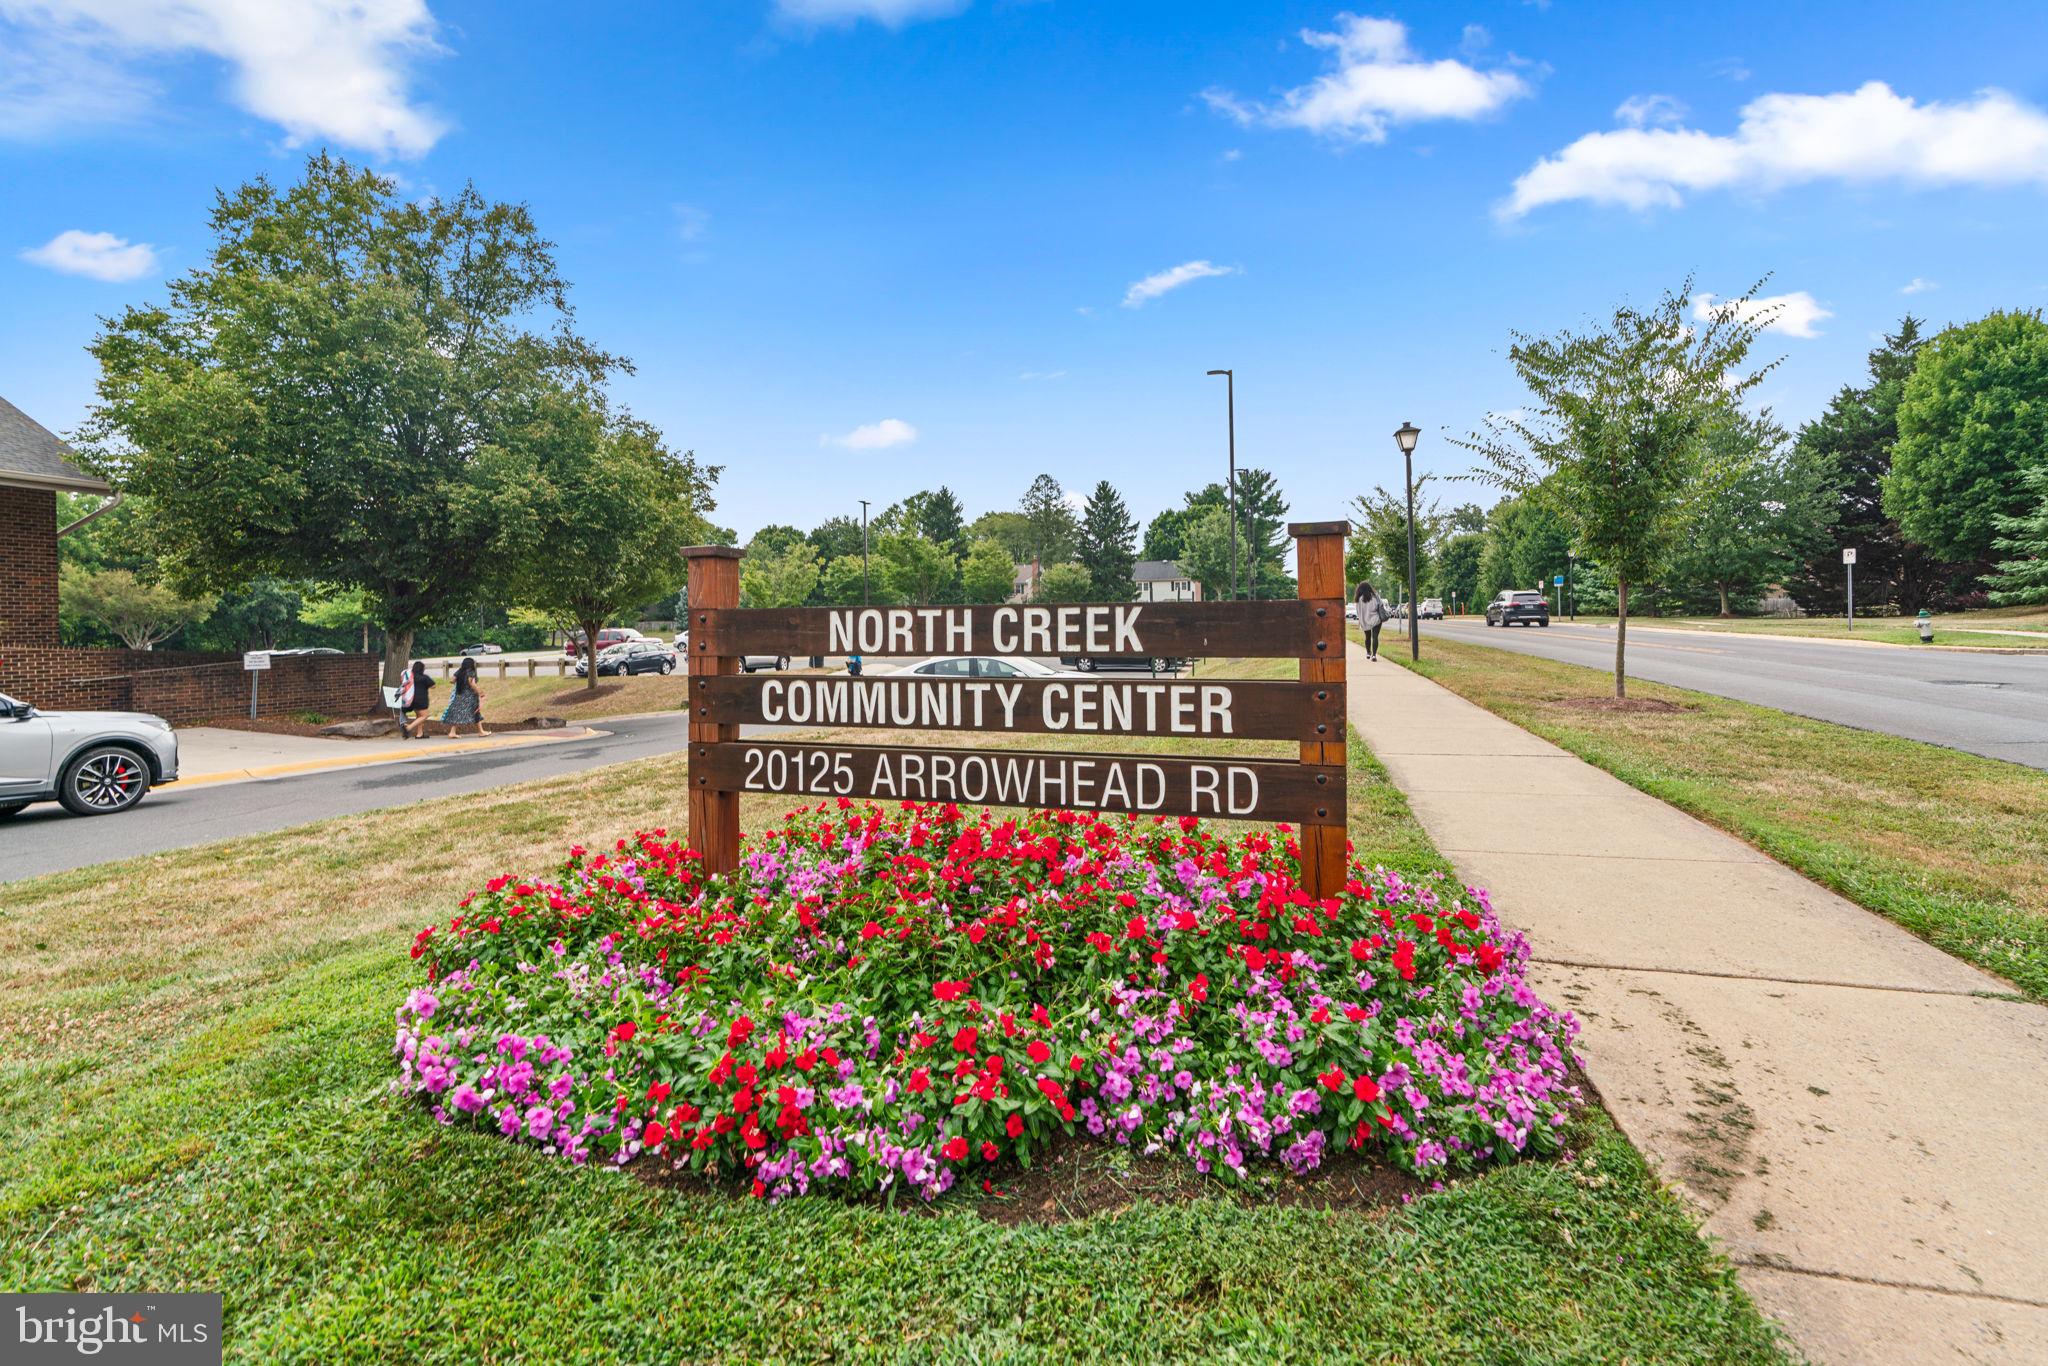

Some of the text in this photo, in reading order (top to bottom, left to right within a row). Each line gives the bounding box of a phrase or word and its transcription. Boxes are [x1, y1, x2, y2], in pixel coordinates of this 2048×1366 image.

[828, 606, 1144, 653] NORTH CREEK
[761, 679, 1234, 734] COMMUNITY CENTER
[744, 748, 1259, 815] 20125 ARROWHEAD RD
